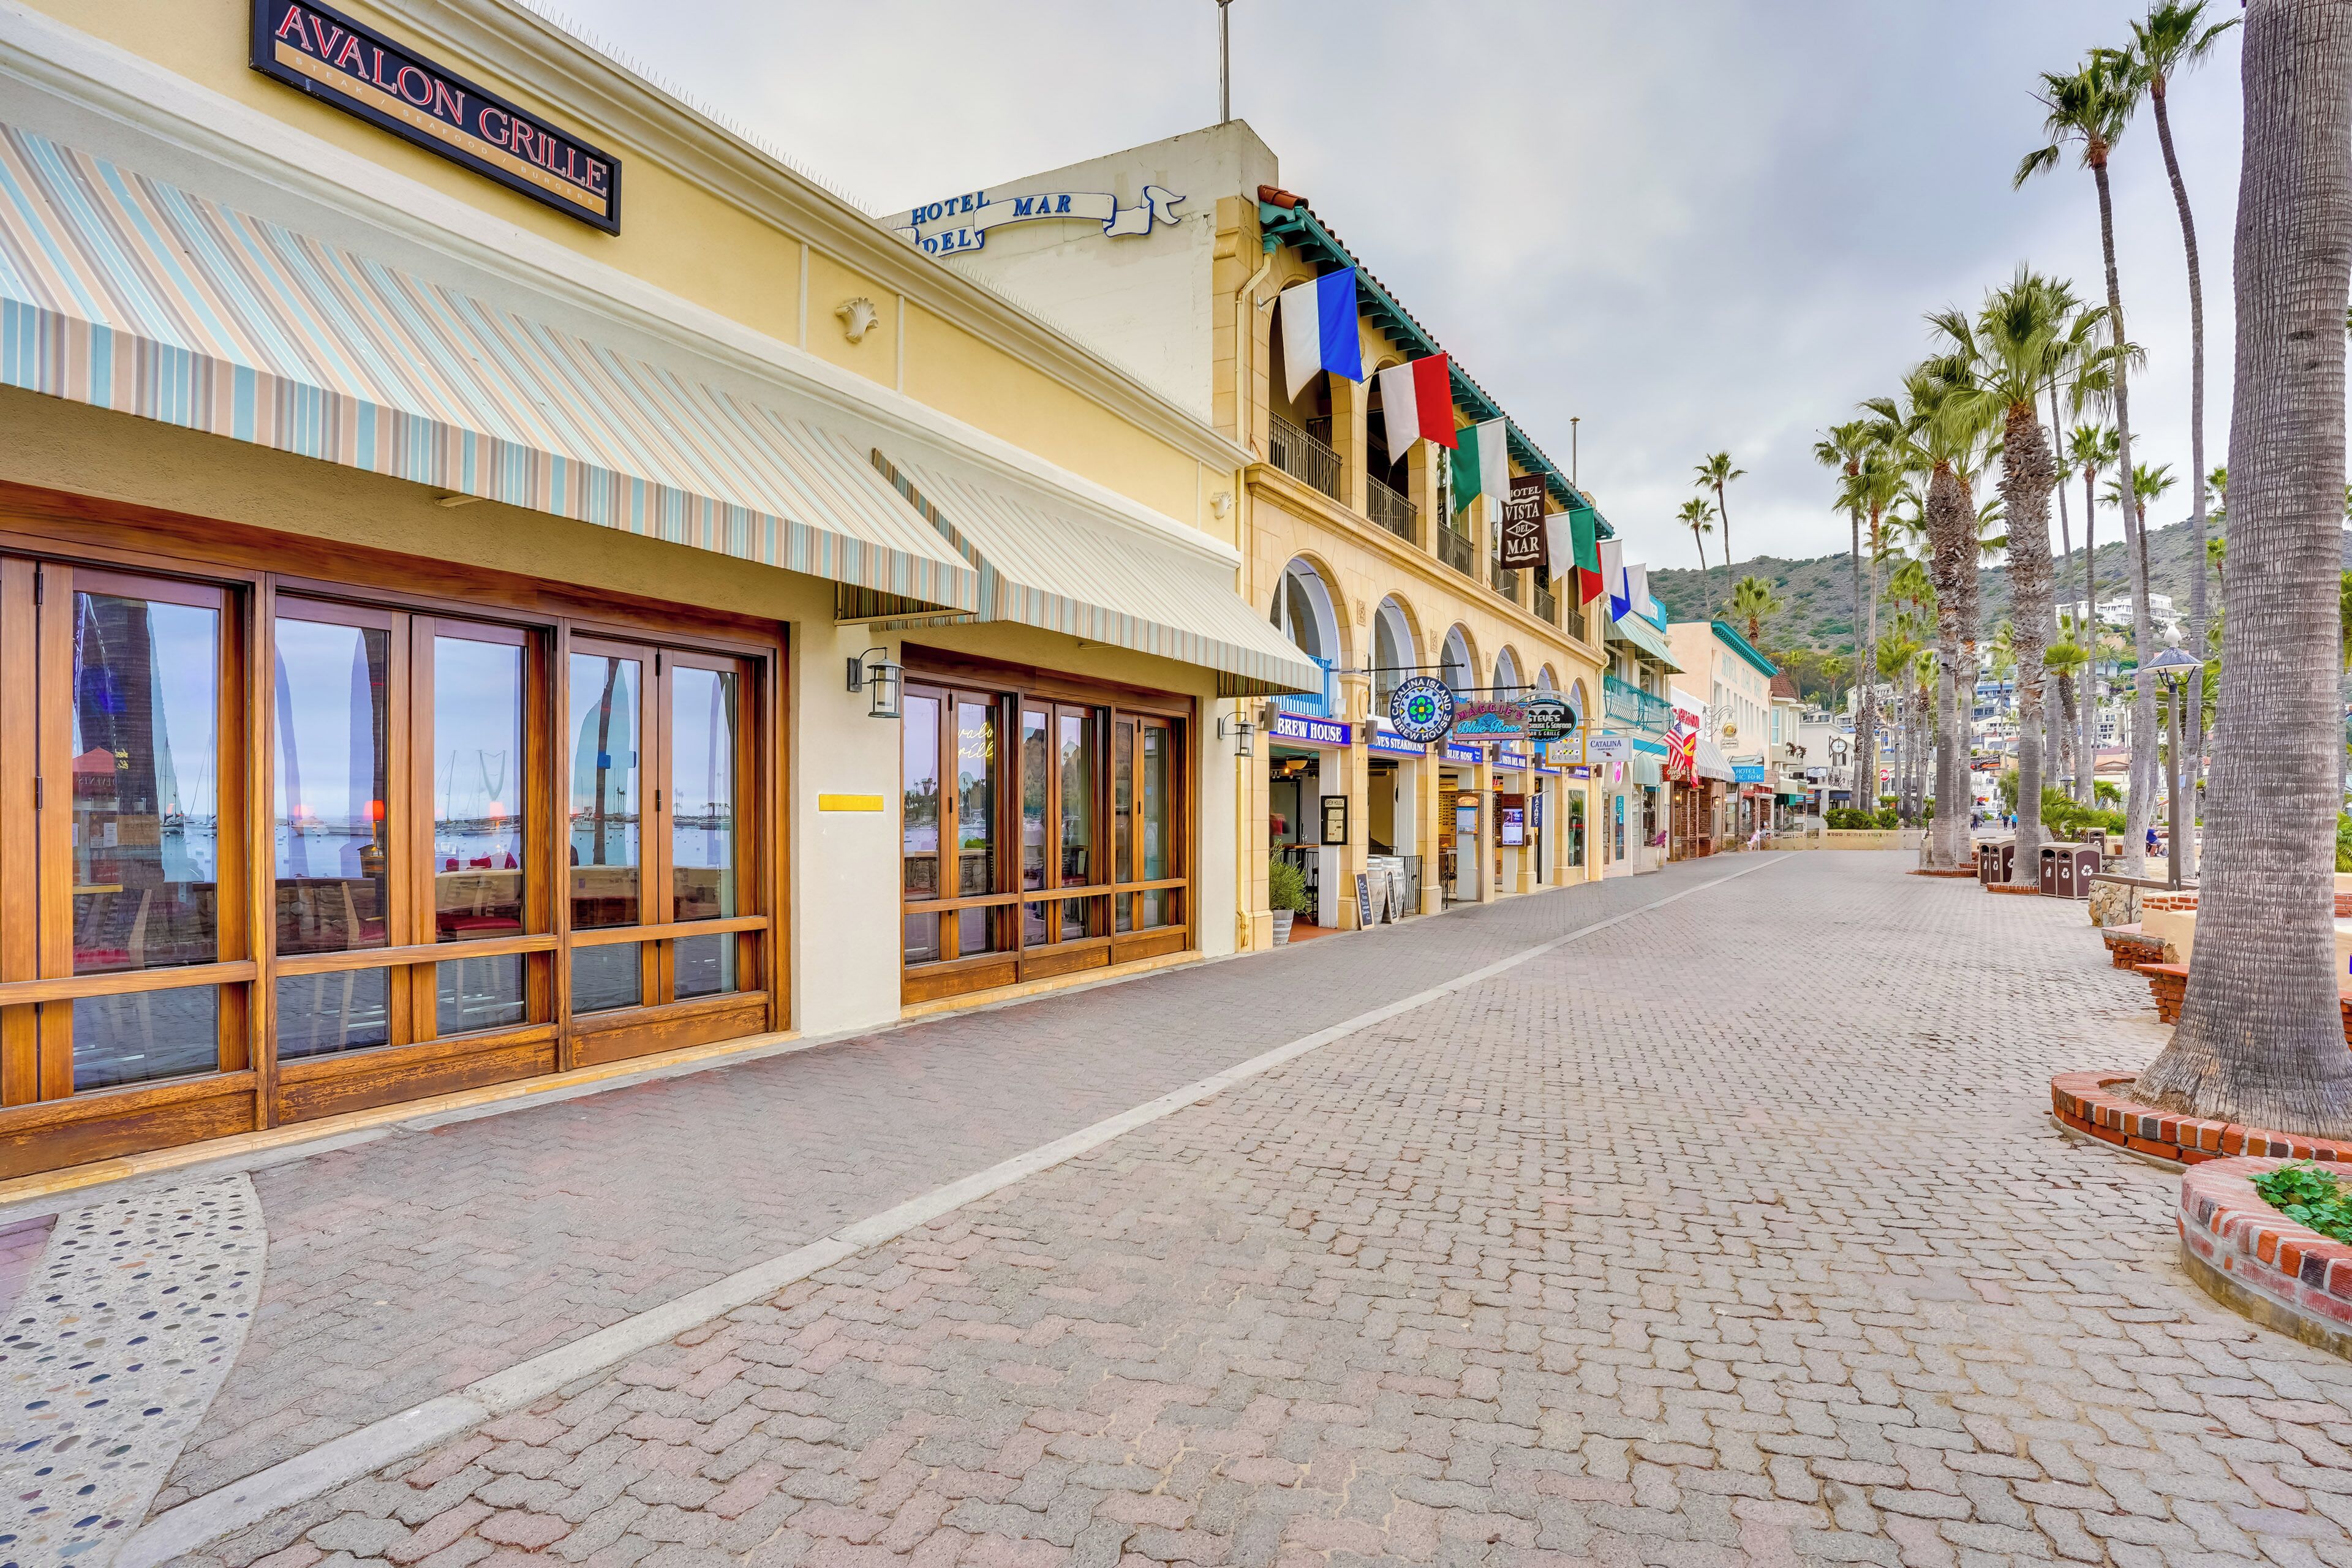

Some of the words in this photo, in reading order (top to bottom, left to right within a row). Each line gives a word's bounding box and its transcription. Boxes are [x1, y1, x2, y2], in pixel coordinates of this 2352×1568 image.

[275, 4, 466, 125] AVALON
[478, 107, 608, 197] GRILLE
[295, 56, 363, 95] STEAK
[402, 108, 488, 155] SEAFOOD
[520, 165, 594, 206] BURGERS
[910, 191, 990, 225] HOTEL
[921, 229, 971, 253] DEL
[1012, 195, 1071, 217] MAR
[1506, 502, 1540, 521] VISTA
[1515, 524, 1530, 533] DEL
[1507, 537, 1540, 555] MAR
[1392, 678, 1425, 715] CATALINA
[1426, 679, 1451, 710] ISLAND
[1456, 703, 1525, 721] MAGGIE'S
[1277, 717, 1308, 737] BREW
[1311, 723, 1343, 742] HOUSE
[1393, 718, 1420, 741] BREW
[1422, 714, 1452, 741] HOUSE
[1457, 720, 1487, 734] Blue
[1489, 719, 1523, 733] Rose
[1390, 737, 1425, 752] STEAKHOUSE
[1447, 749, 1460, 760] BLUE
[1460, 751, 1473, 761] ROSE
